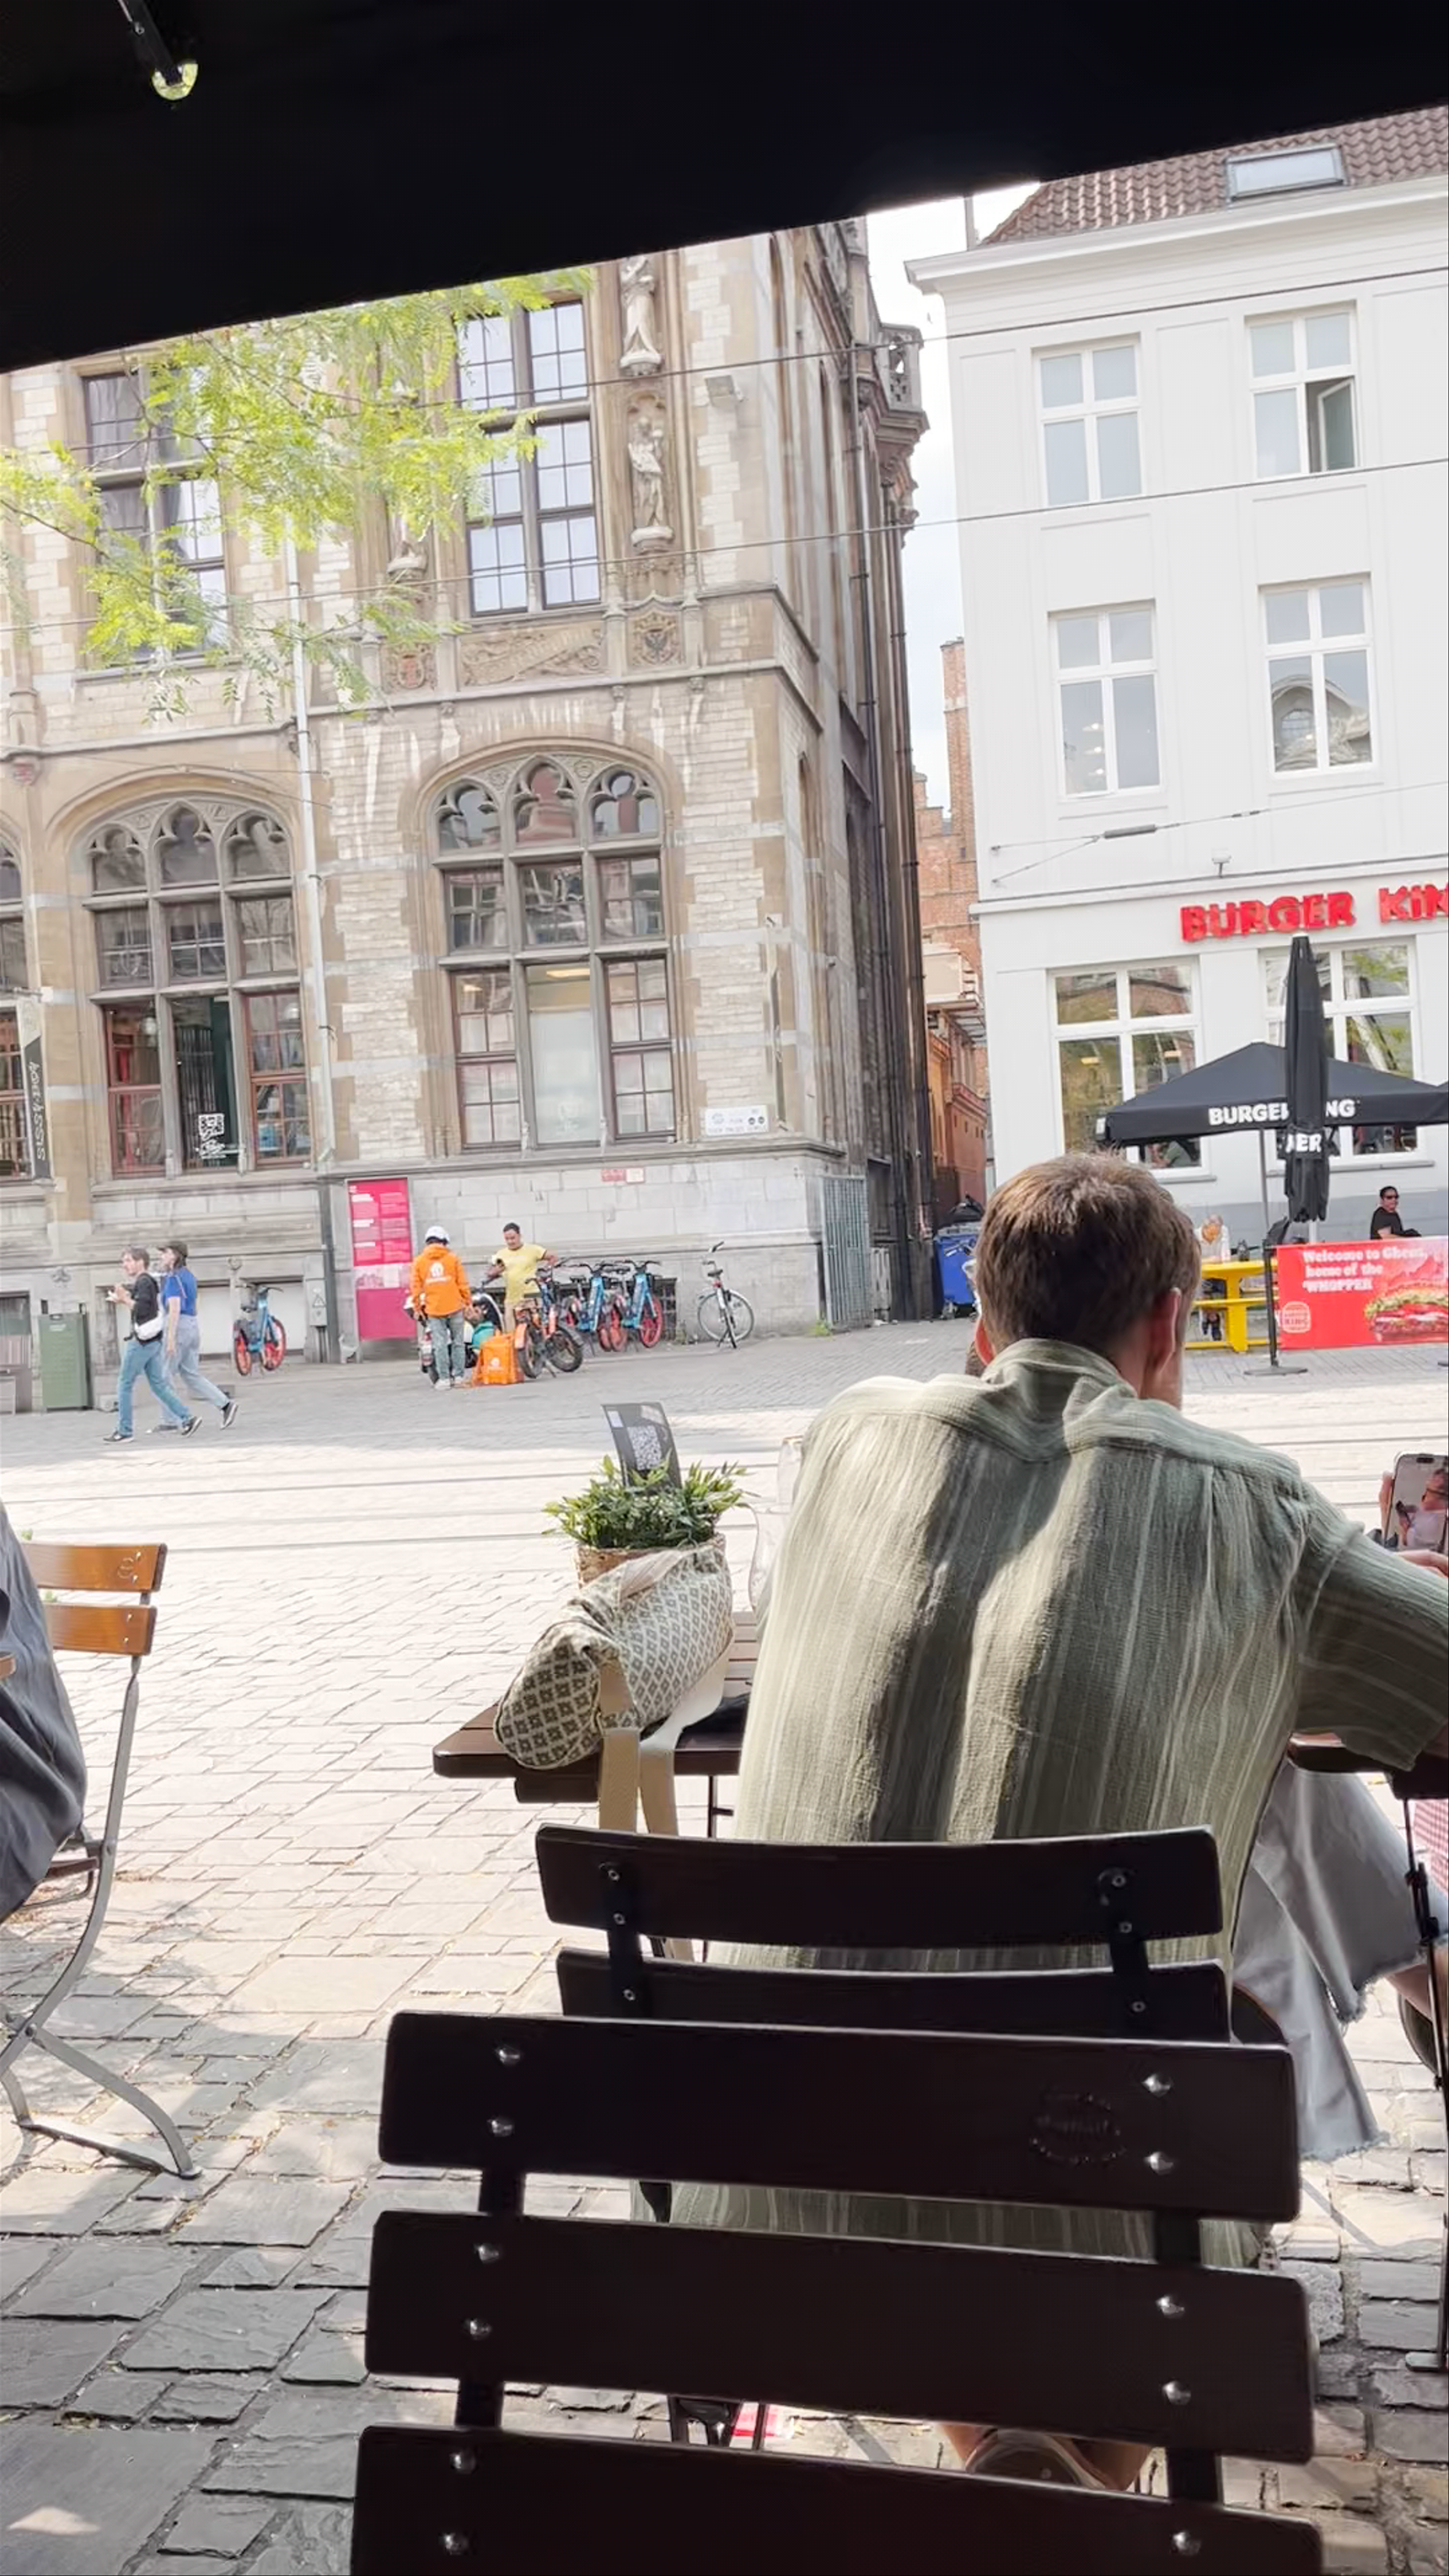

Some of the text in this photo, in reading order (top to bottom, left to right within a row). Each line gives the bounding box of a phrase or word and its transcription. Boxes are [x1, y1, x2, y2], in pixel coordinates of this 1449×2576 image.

[1181, 892, 1357, 942] BURGER
[1326, 1099, 1356, 1118] NG
[1303, 1249, 1363, 1263] Welcome
[1366, 1249, 1380, 1260] to
